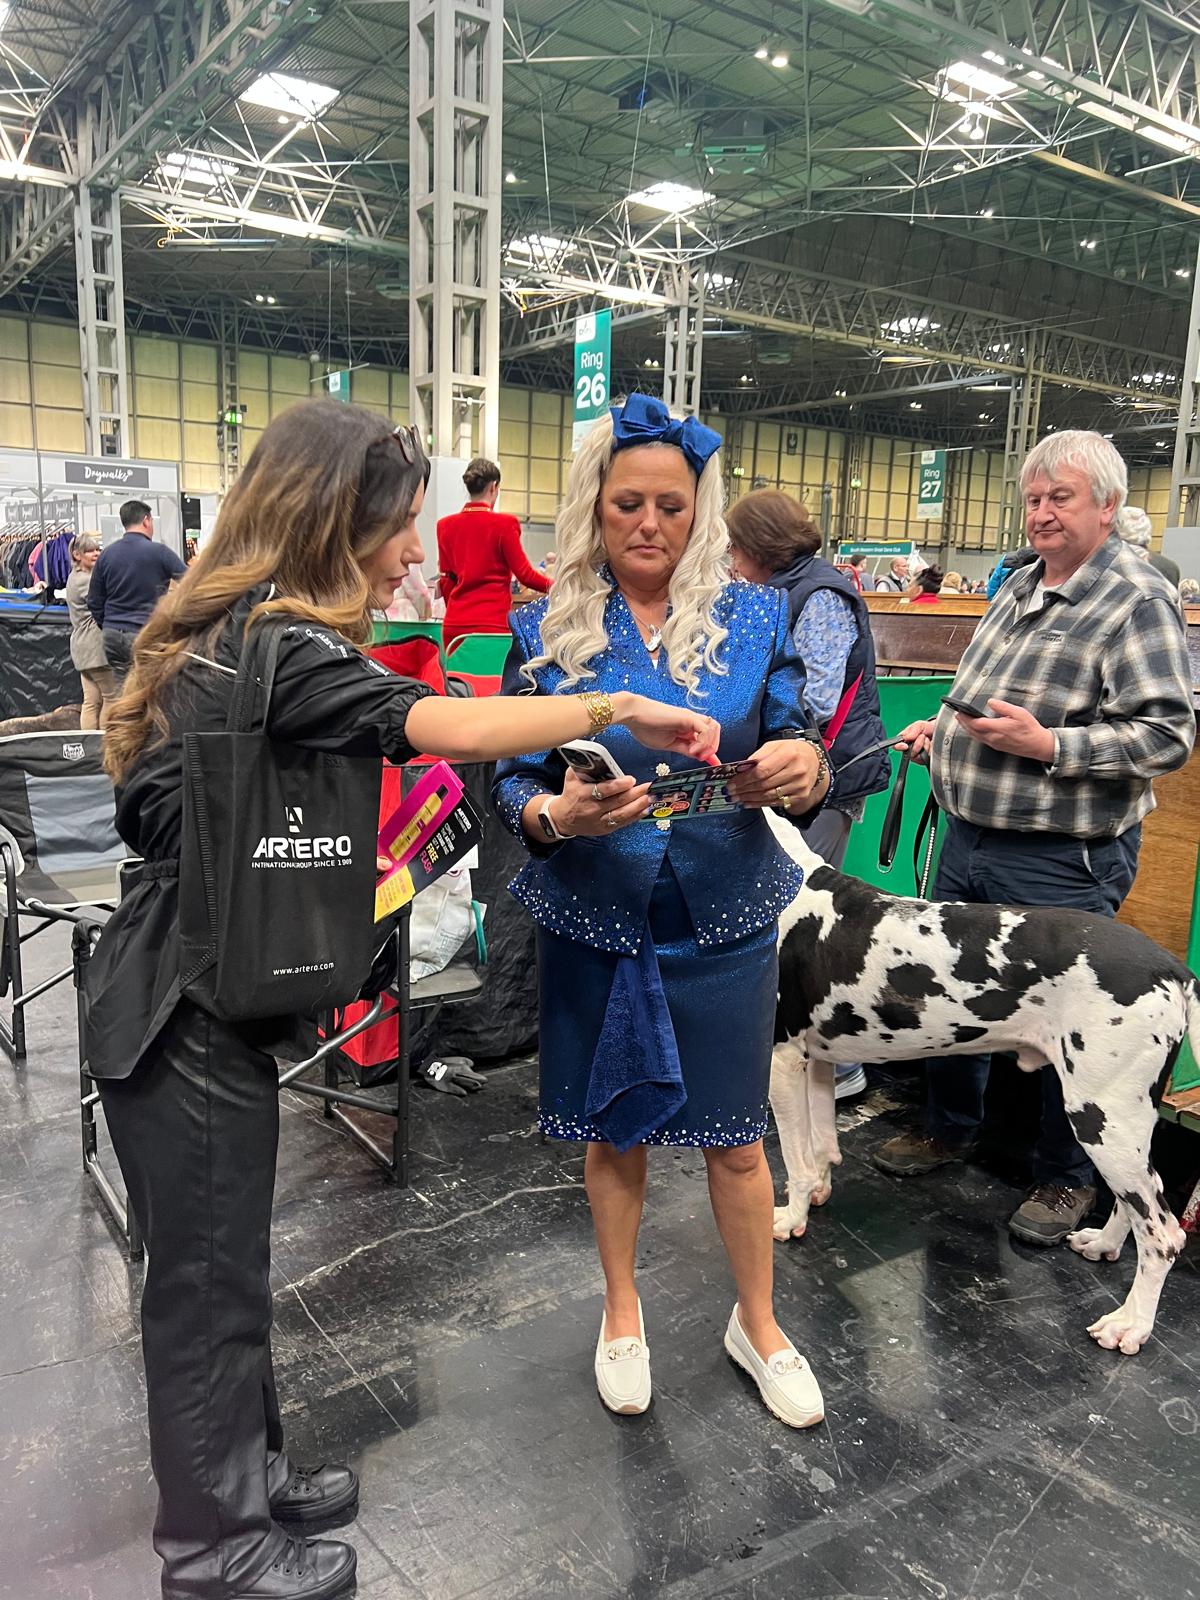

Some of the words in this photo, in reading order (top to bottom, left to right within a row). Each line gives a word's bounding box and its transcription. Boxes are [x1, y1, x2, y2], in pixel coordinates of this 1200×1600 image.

[581, 352, 603, 370] Ring
[576, 372, 606, 409] 26
[84, 466, 129, 483] Drywalks
[924, 469, 940, 479] Ring
[921, 480, 941, 498] 27
[252, 836, 351, 858] ARTERO
[425, 842, 439, 864] FREE
[313, 860, 335, 868] SINCE
[420, 850, 434, 874] FLASH
[272, 962, 335, 976] www.artero.com
